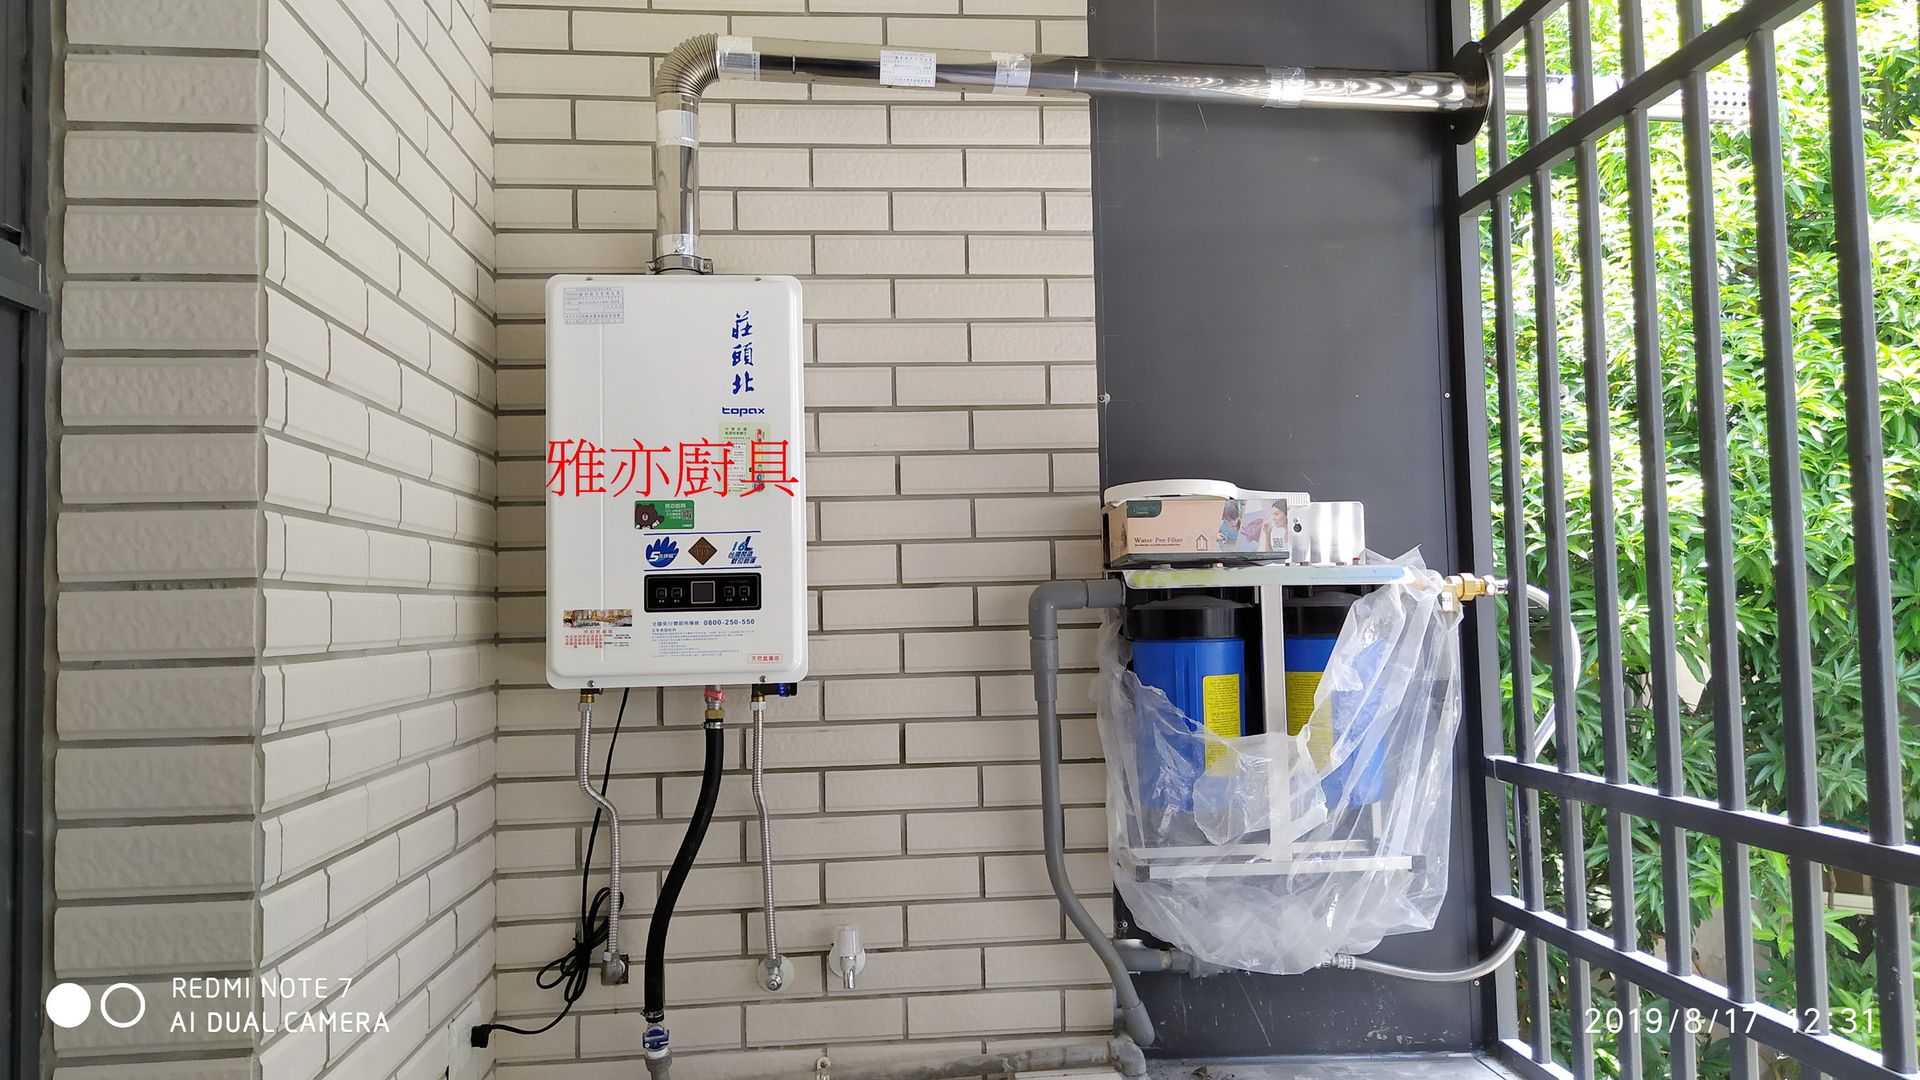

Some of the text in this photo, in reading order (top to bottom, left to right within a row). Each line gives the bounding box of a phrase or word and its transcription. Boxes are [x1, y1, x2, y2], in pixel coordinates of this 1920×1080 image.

[731, 310, 755, 395] 莊頭北
[722, 407, 765, 417] topax
[703, 618, 755, 626] 0800-250-550
